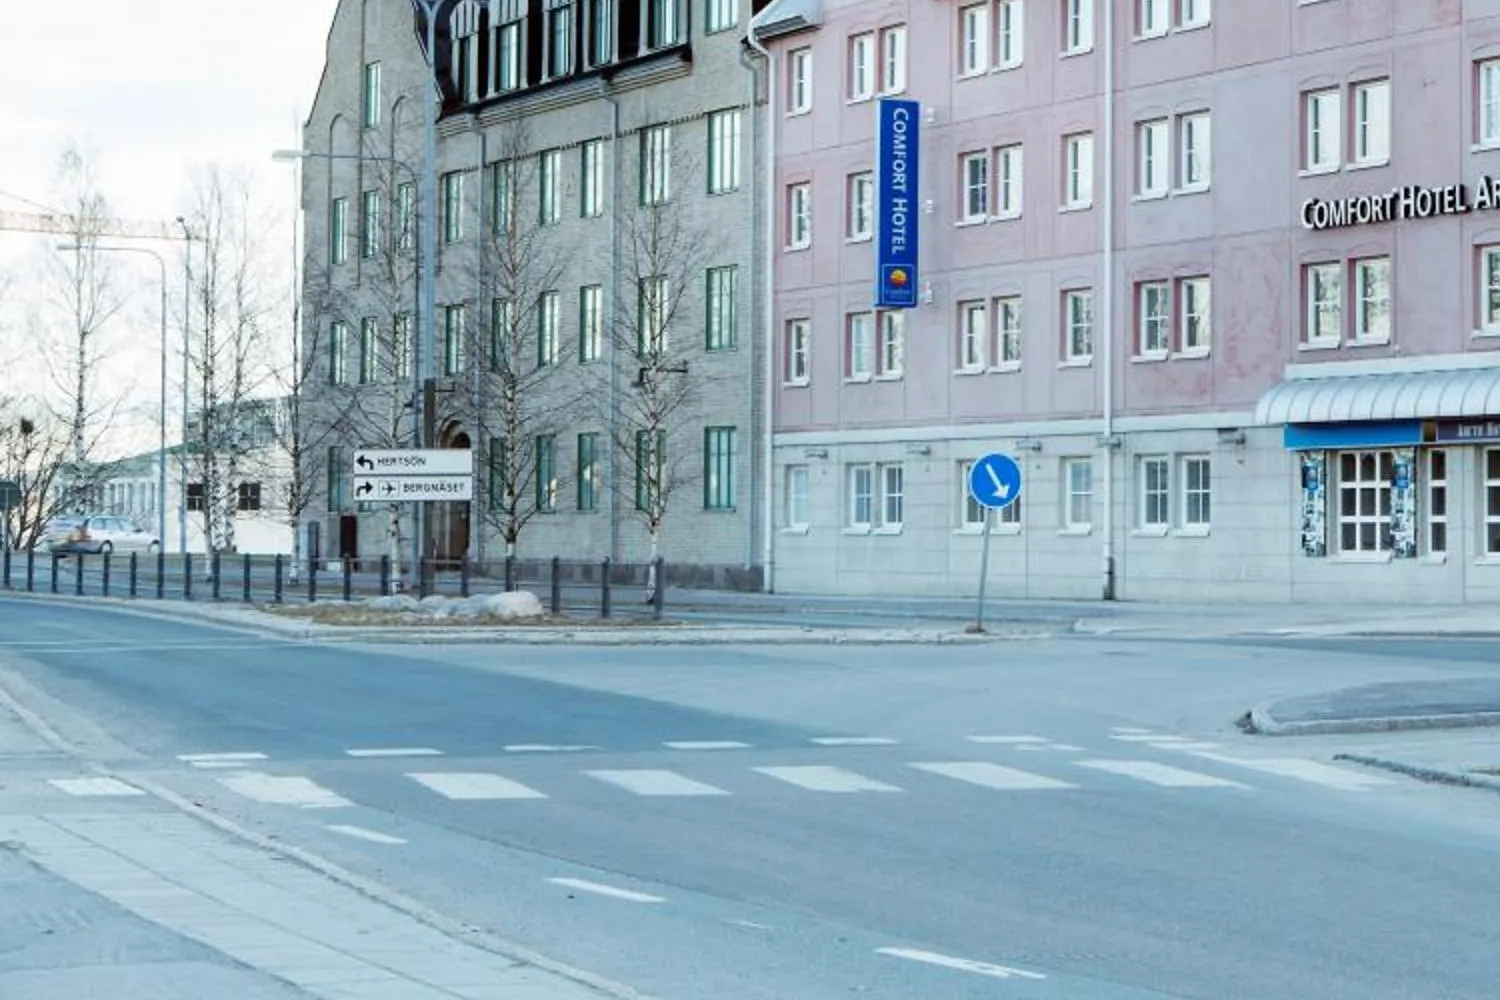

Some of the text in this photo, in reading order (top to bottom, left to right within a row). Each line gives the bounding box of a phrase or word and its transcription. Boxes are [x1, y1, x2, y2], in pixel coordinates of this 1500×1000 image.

[891, 107, 909, 255] COMFORT HOTEL
[1301, 193, 1393, 229] COMFORT
[1400, 184, 1467, 217] HOTEL
[403, 481, 465, 493] BERGNÄSET
